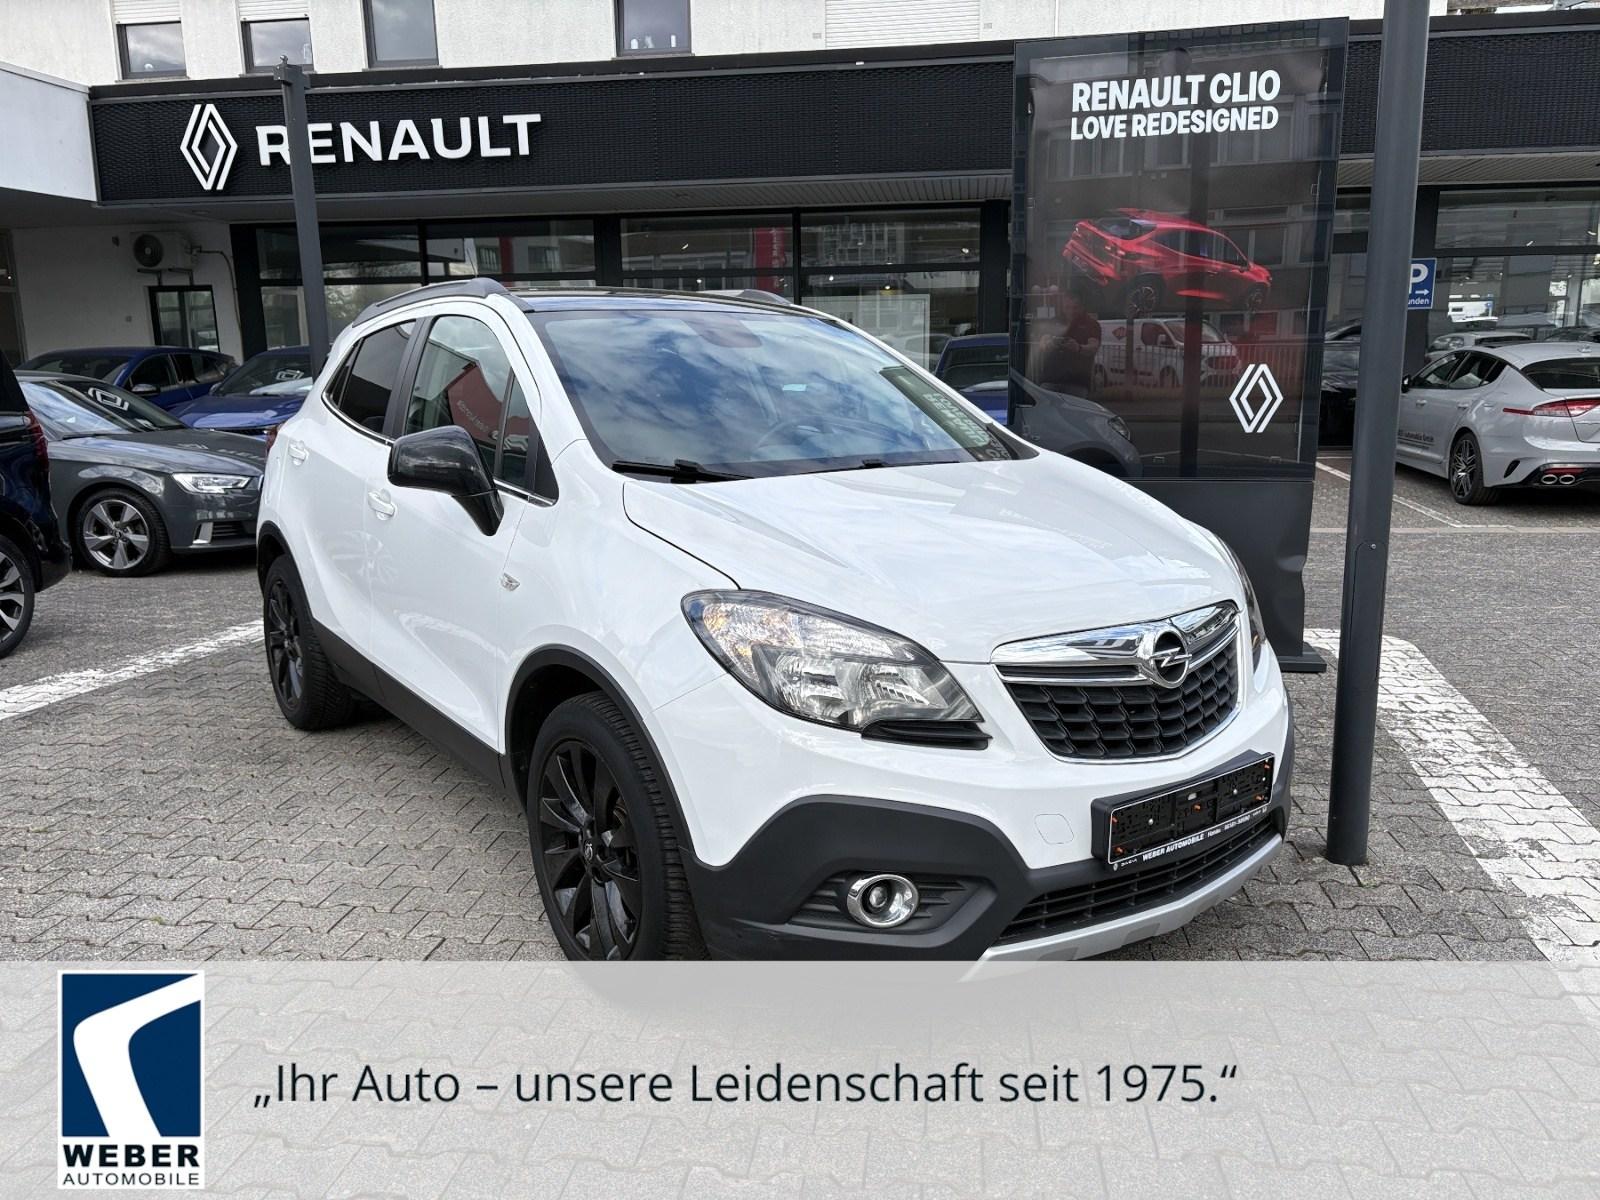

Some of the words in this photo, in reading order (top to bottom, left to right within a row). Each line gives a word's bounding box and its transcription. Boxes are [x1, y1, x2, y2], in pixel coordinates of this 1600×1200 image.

[1072, 75, 1205, 112] RENAULT
[1210, 70, 1281, 103] CLIO
[1071, 115, 1128, 140] LOVE
[1132, 106, 1279, 138] REDESIGNED
[256, 114, 541, 166] RENAULT
[1408, 263, 1429, 294] P
[1407, 297, 1430, 305] unden
[1142, 847, 1165, 862] WEBER
[1165, 833, 1205, 854] AUTOMOBILE
